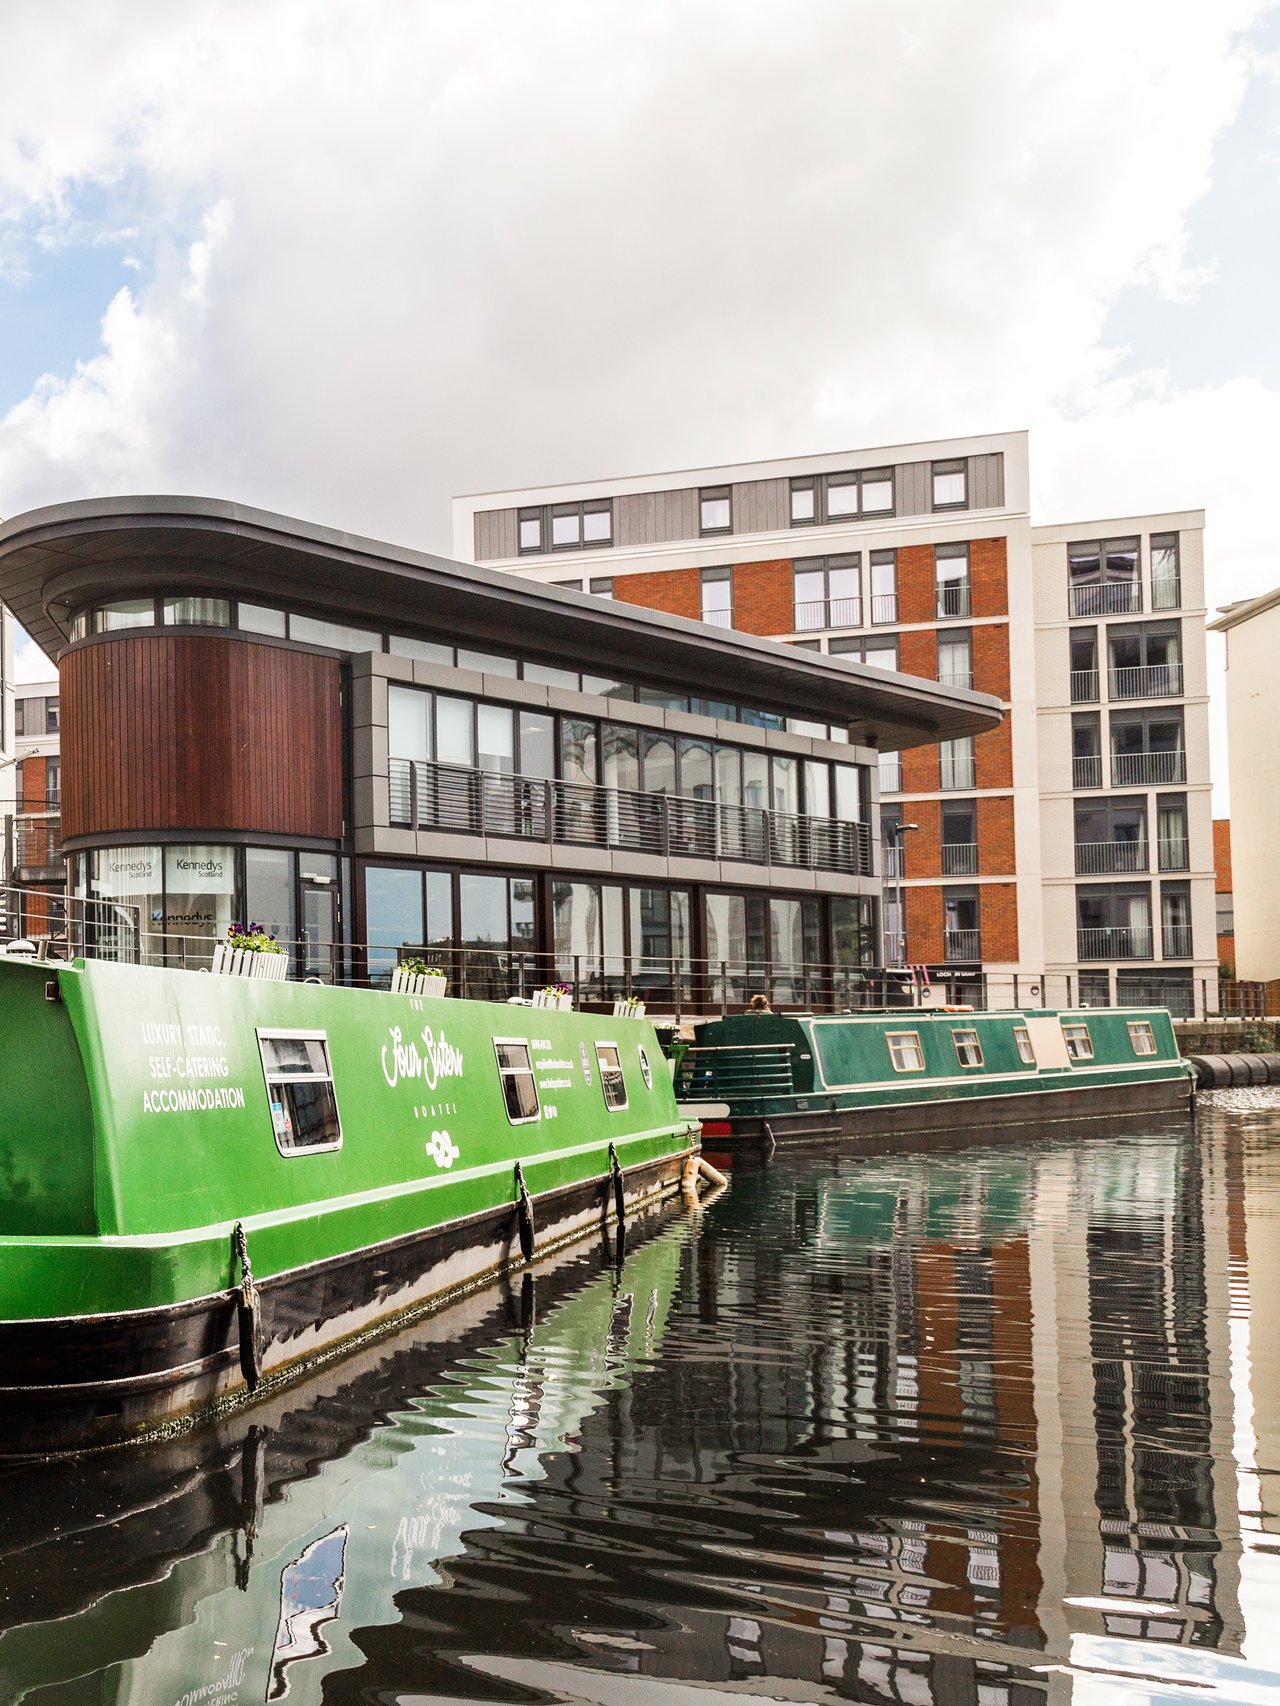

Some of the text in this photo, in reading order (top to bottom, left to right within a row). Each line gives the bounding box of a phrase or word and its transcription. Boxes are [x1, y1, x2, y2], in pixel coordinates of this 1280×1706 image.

[110, 859, 152, 873] Kennedys
[176, 859, 223, 873] Kennedys
[128, 871, 153, 879] Scotland
[151, 911, 213, 928] Knnedys
[409, 998, 424, 1011] THE
[141, 1022, 226, 1048] LUXURY, STATIC,
[381, 1024, 464, 1091] Four Sisters
[148, 1055, 229, 1079] SELF-CATERING
[143, 1087, 246, 1113] ACCOMMODATION
[413, 1102, 457, 1118] BOATEL
